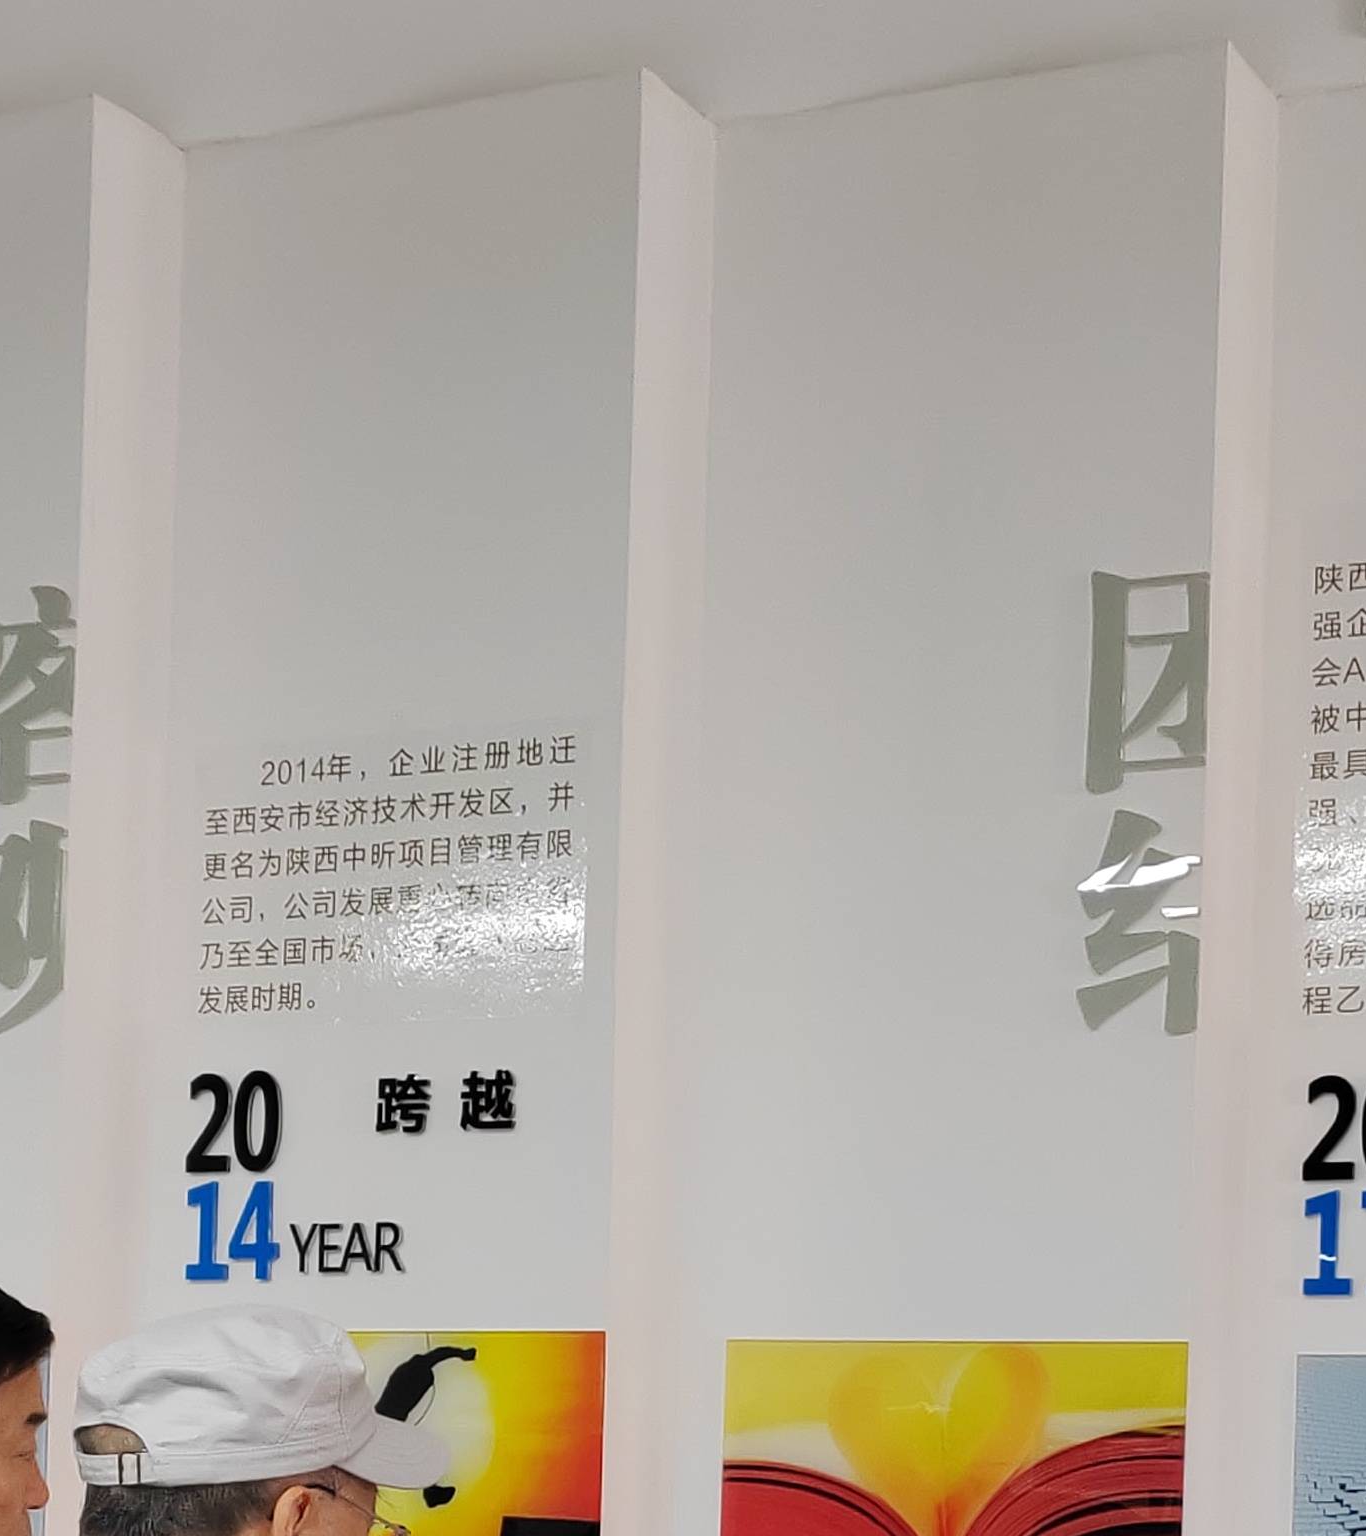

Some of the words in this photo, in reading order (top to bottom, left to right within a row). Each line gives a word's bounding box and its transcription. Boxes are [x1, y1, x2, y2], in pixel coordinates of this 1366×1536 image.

[260, 735, 576, 786] 2014年，企业注册地迁
[204, 782, 575, 836] 至西安市经济技术开发区，并
[203, 829, 573, 881] 更名为陕西中昕项目管理有限
[197, 982, 316, 1015] 发展时期。
[185, 1069, 283, 1174] 20
[184, 1180, 280, 1281] 14
[289, 1221, 406, 1275] YEAR
